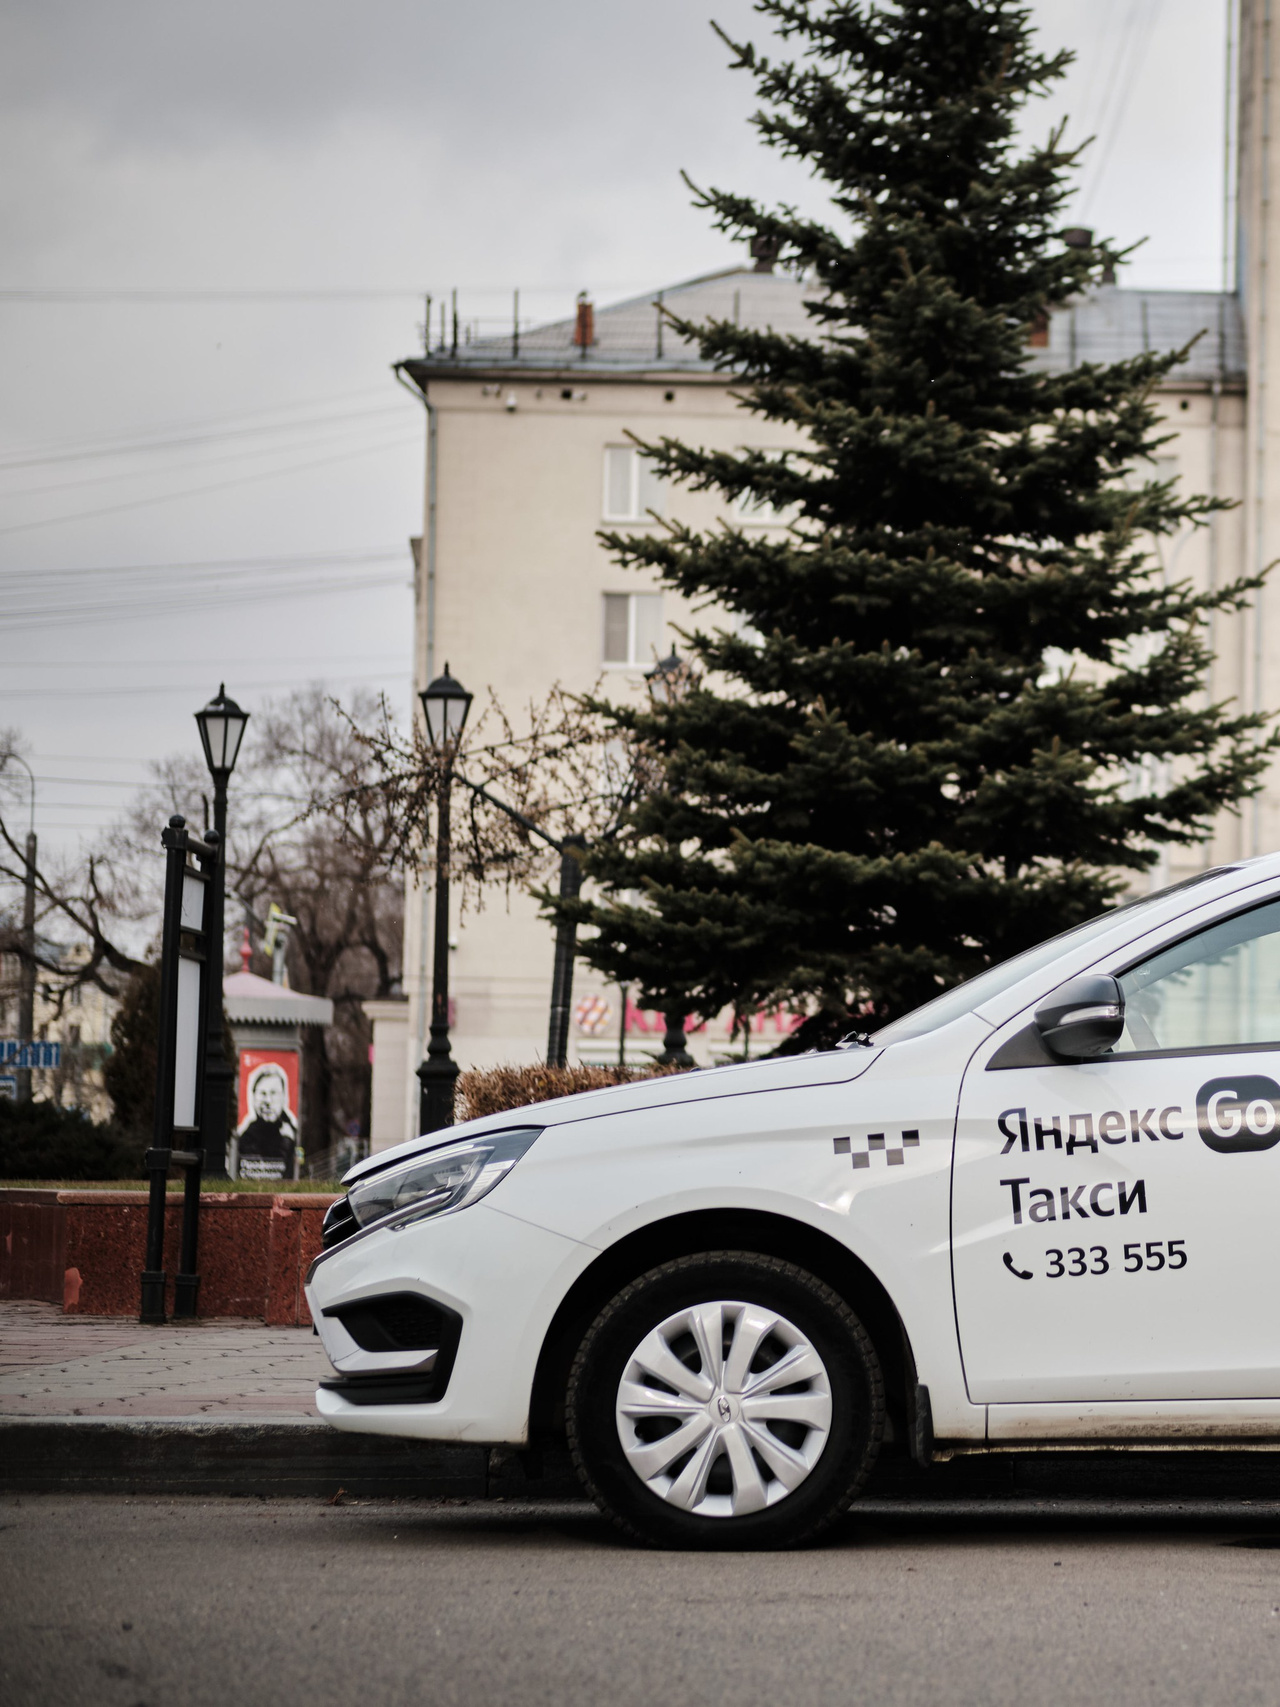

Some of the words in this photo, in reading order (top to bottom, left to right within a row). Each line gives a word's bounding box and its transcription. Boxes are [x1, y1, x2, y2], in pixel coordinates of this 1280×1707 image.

[997, 1106, 1185, 1156] Яндекс
[1206, 1090, 1277, 1139] Go
[999, 1176, 1148, 1225] Такси
[1045, 1245, 1110, 1279] 333
[1123, 1239, 1188, 1273] 555
